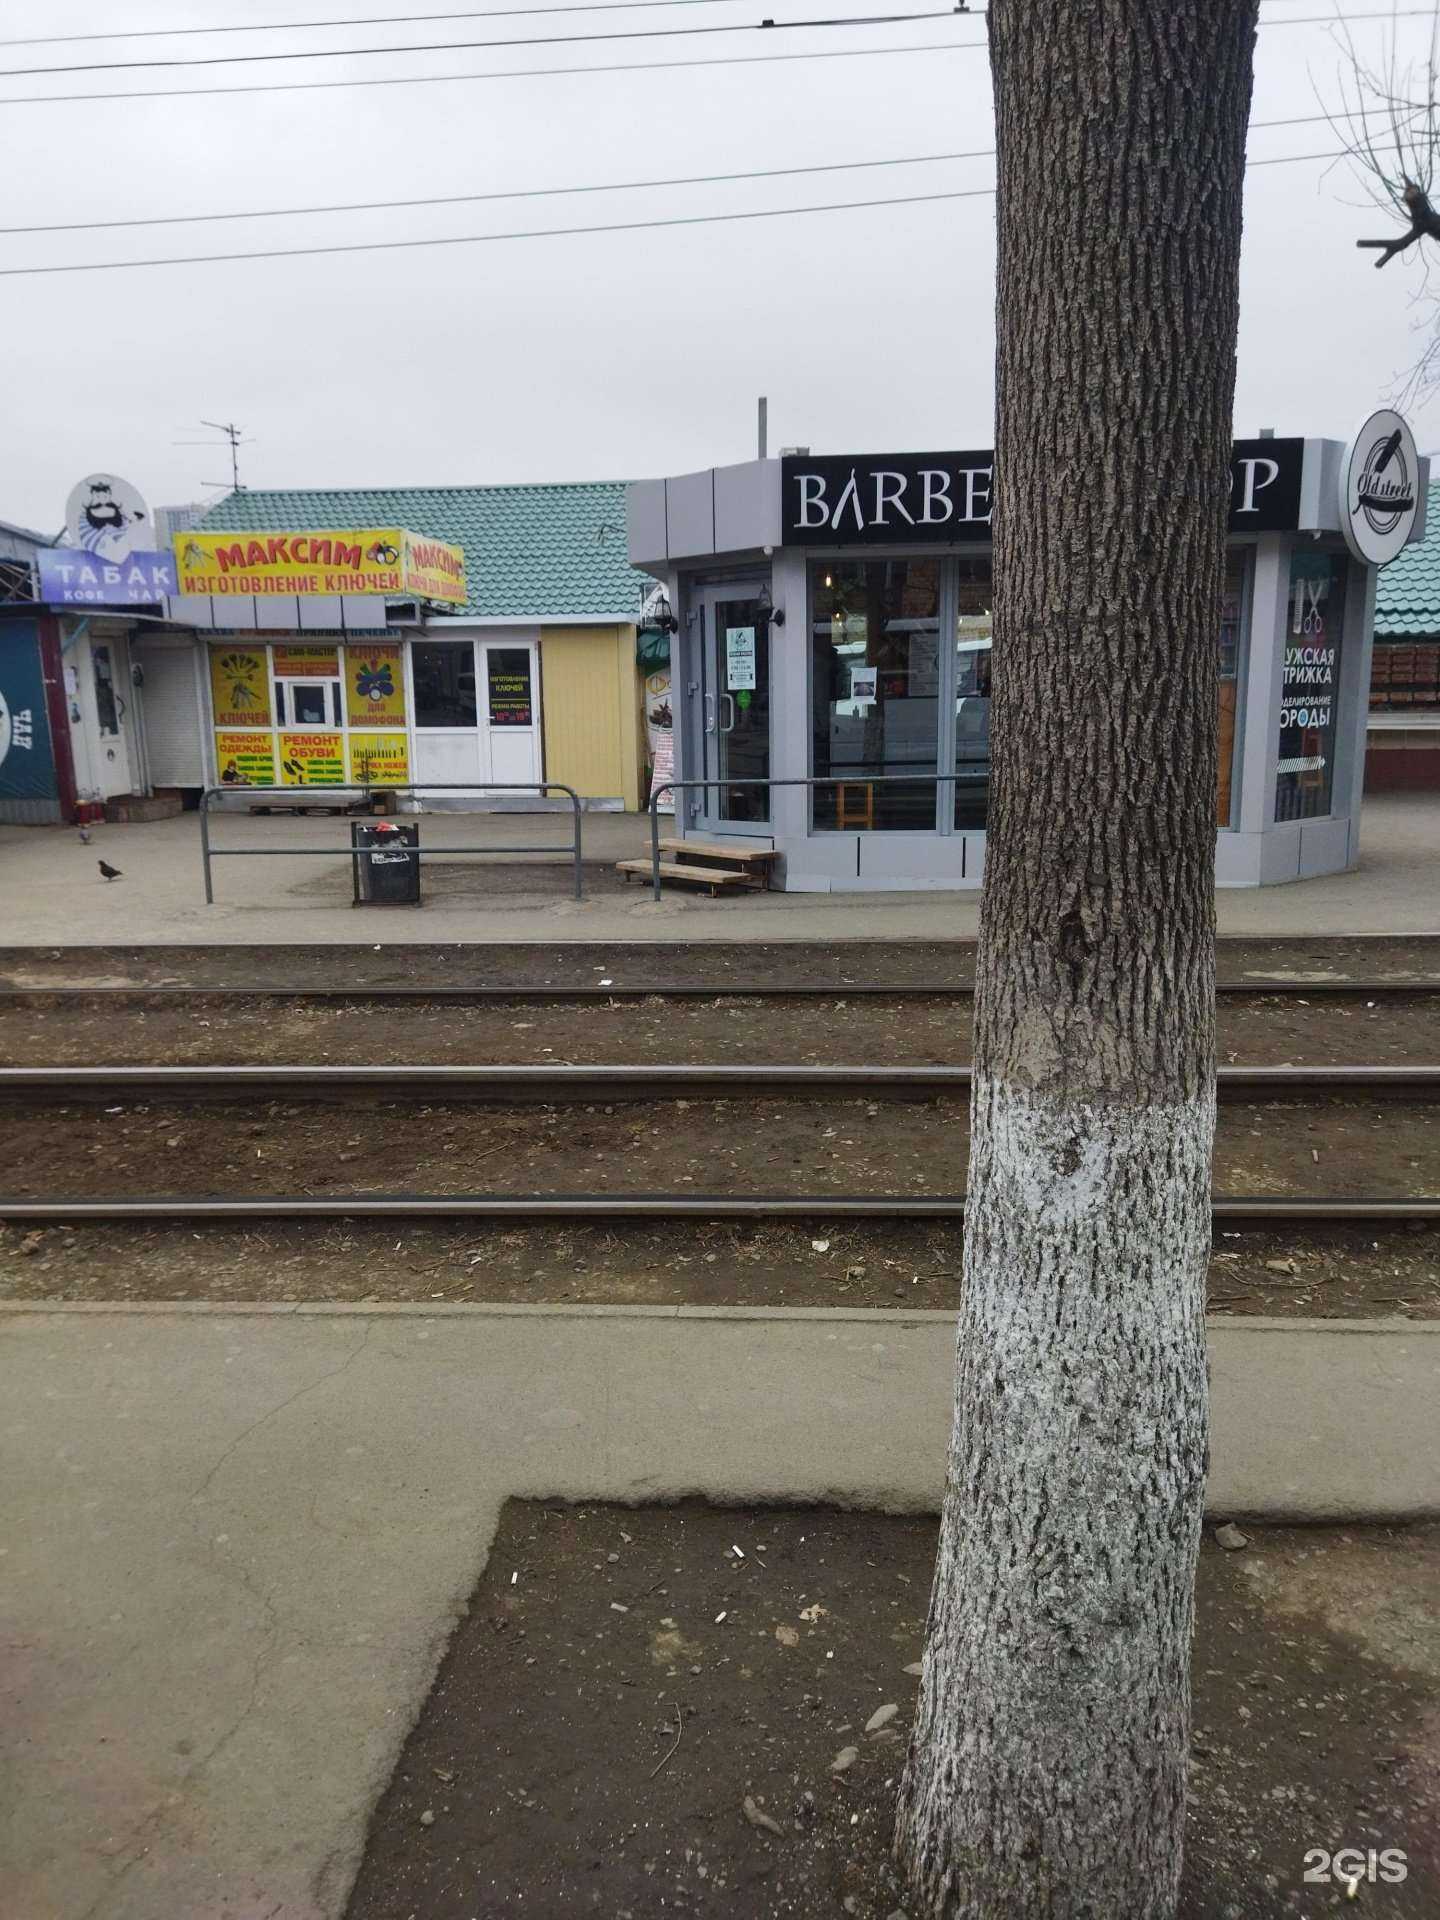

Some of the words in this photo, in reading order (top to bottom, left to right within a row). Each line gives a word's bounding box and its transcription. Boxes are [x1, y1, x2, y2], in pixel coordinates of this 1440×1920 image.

[1357, 472, 1381, 496] Old
[793, 465, 994, 532] BARBE
[1235, 457, 1280, 513] P
[214, 537, 362, 573] МАКСИМ
[54, 565, 170, 585] ТАБАК
[185, 575, 318, 594] ИЗГОТОВЛЕНИЕ
[325, 569, 401, 592] КЛЮЧЕЙ
[1285, 647, 1335, 666] УЖСКАЯ
[1282, 666, 1333, 684] ТРИЖКА
[495, 683, 524, 693] КЛЮЧЕЙ
[1281, 695, 1332, 707] ДЕЛИРОВАНИЕ
[219, 711, 269, 726] КЛЮЧЕЙ
[1280, 707, 1331, 729] ОРОДЫ
[222, 735, 267, 744] РЕМОНТ
[283, 736, 340, 746] РЕМОНТ
[219, 744, 272, 754] ОДЕЖДЫ
[289, 747, 336, 758] ОБУВИ
